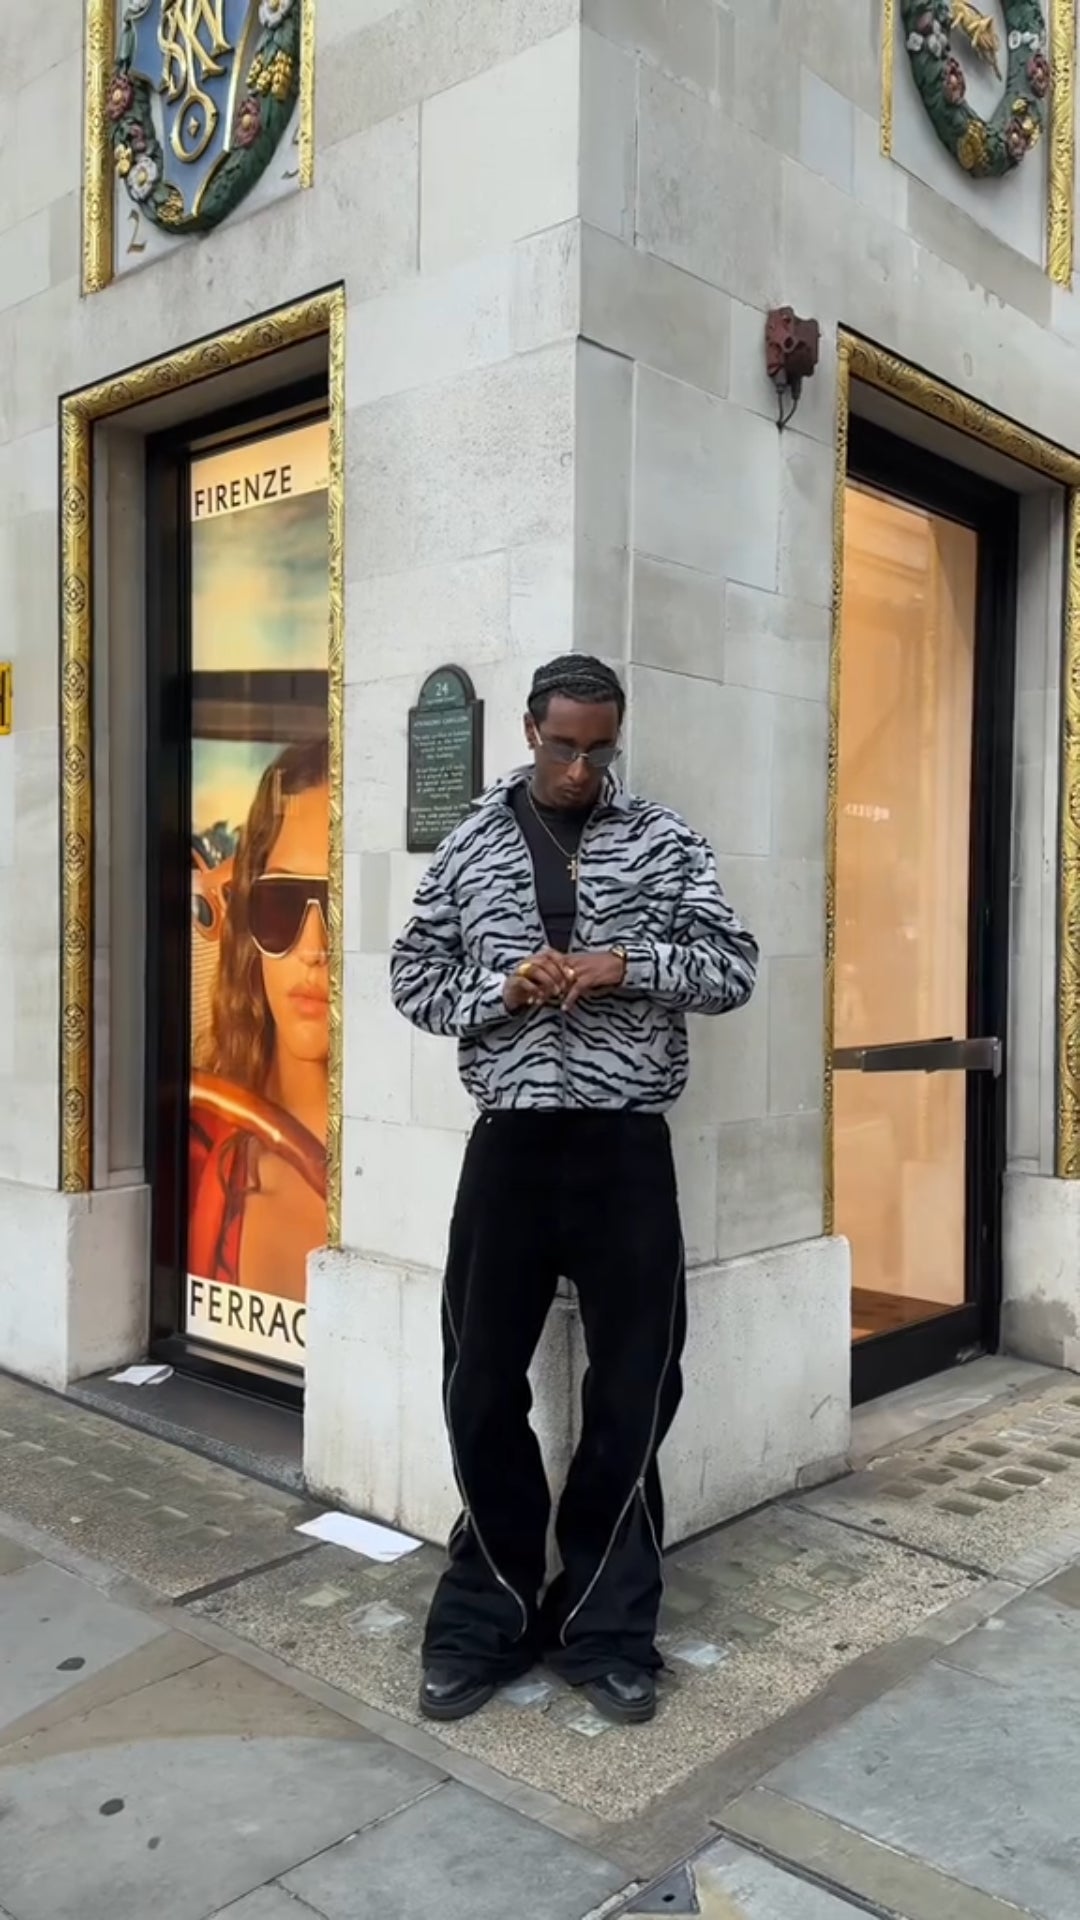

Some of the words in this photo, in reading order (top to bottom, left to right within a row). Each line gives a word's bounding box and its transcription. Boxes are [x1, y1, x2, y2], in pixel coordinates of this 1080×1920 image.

[127, 209, 147, 254] 2
[194, 464, 292, 516] FIRENZE
[435, 682, 449, 696] 24
